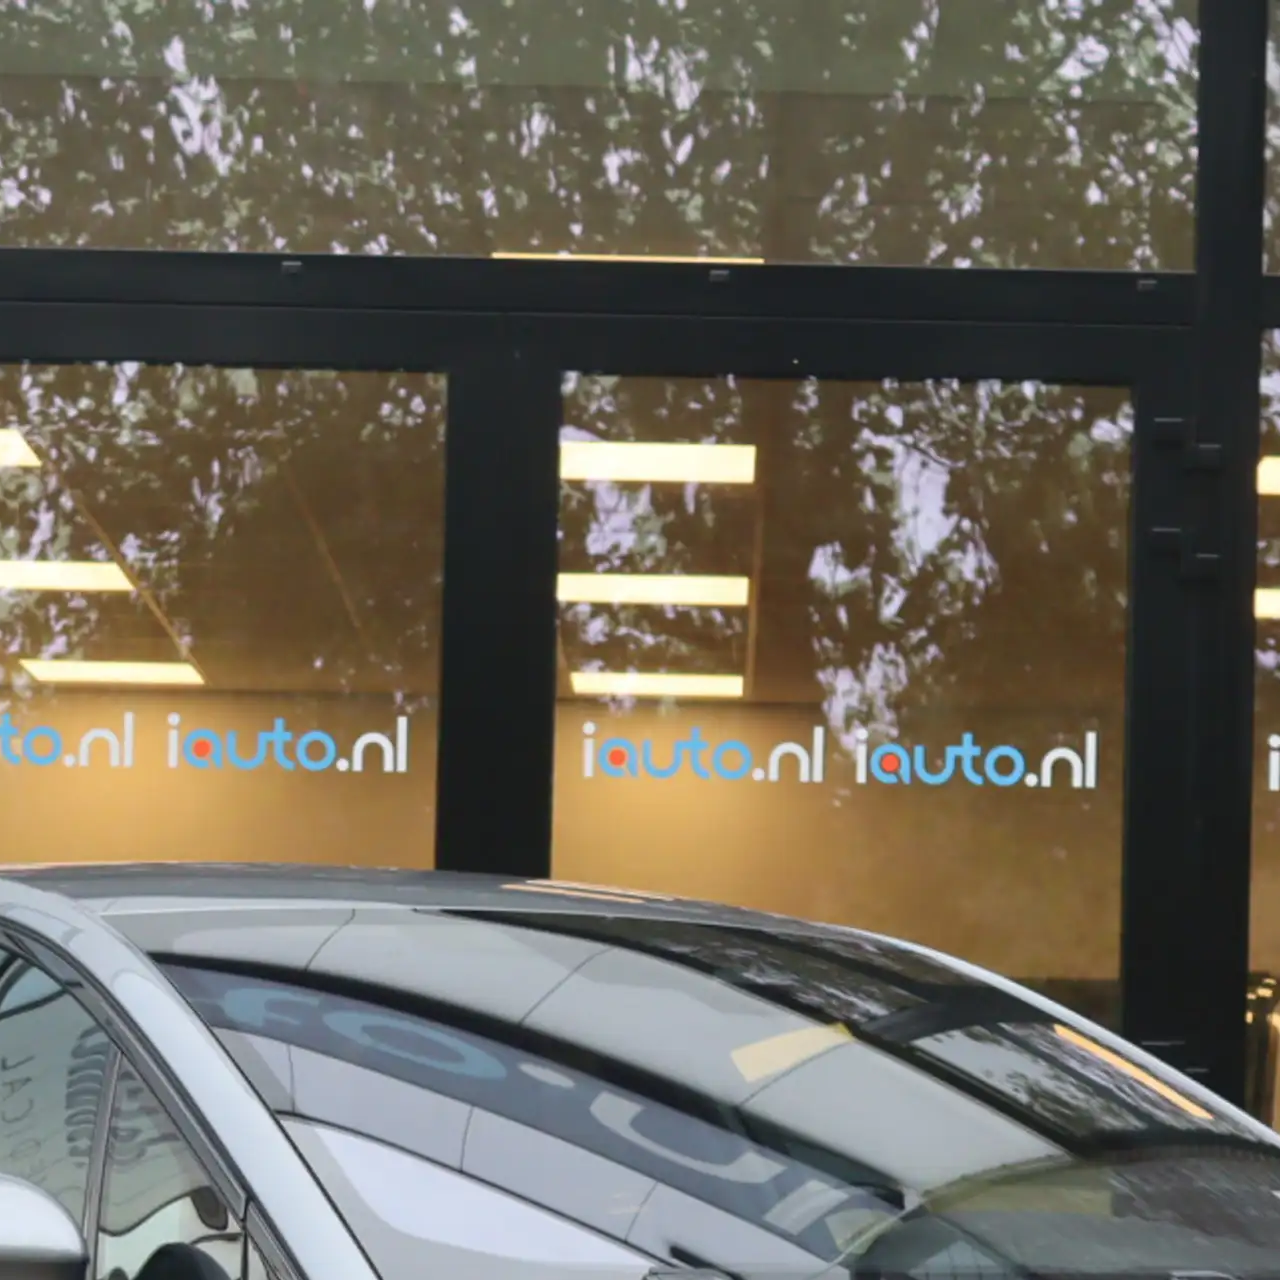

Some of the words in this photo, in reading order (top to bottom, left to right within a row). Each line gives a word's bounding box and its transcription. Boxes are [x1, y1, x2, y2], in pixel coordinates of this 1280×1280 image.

[167, 712, 408, 772] iauto.nl
[583, 721, 824, 783] iauto.nl
[856, 728, 1097, 788] iauto.nl
